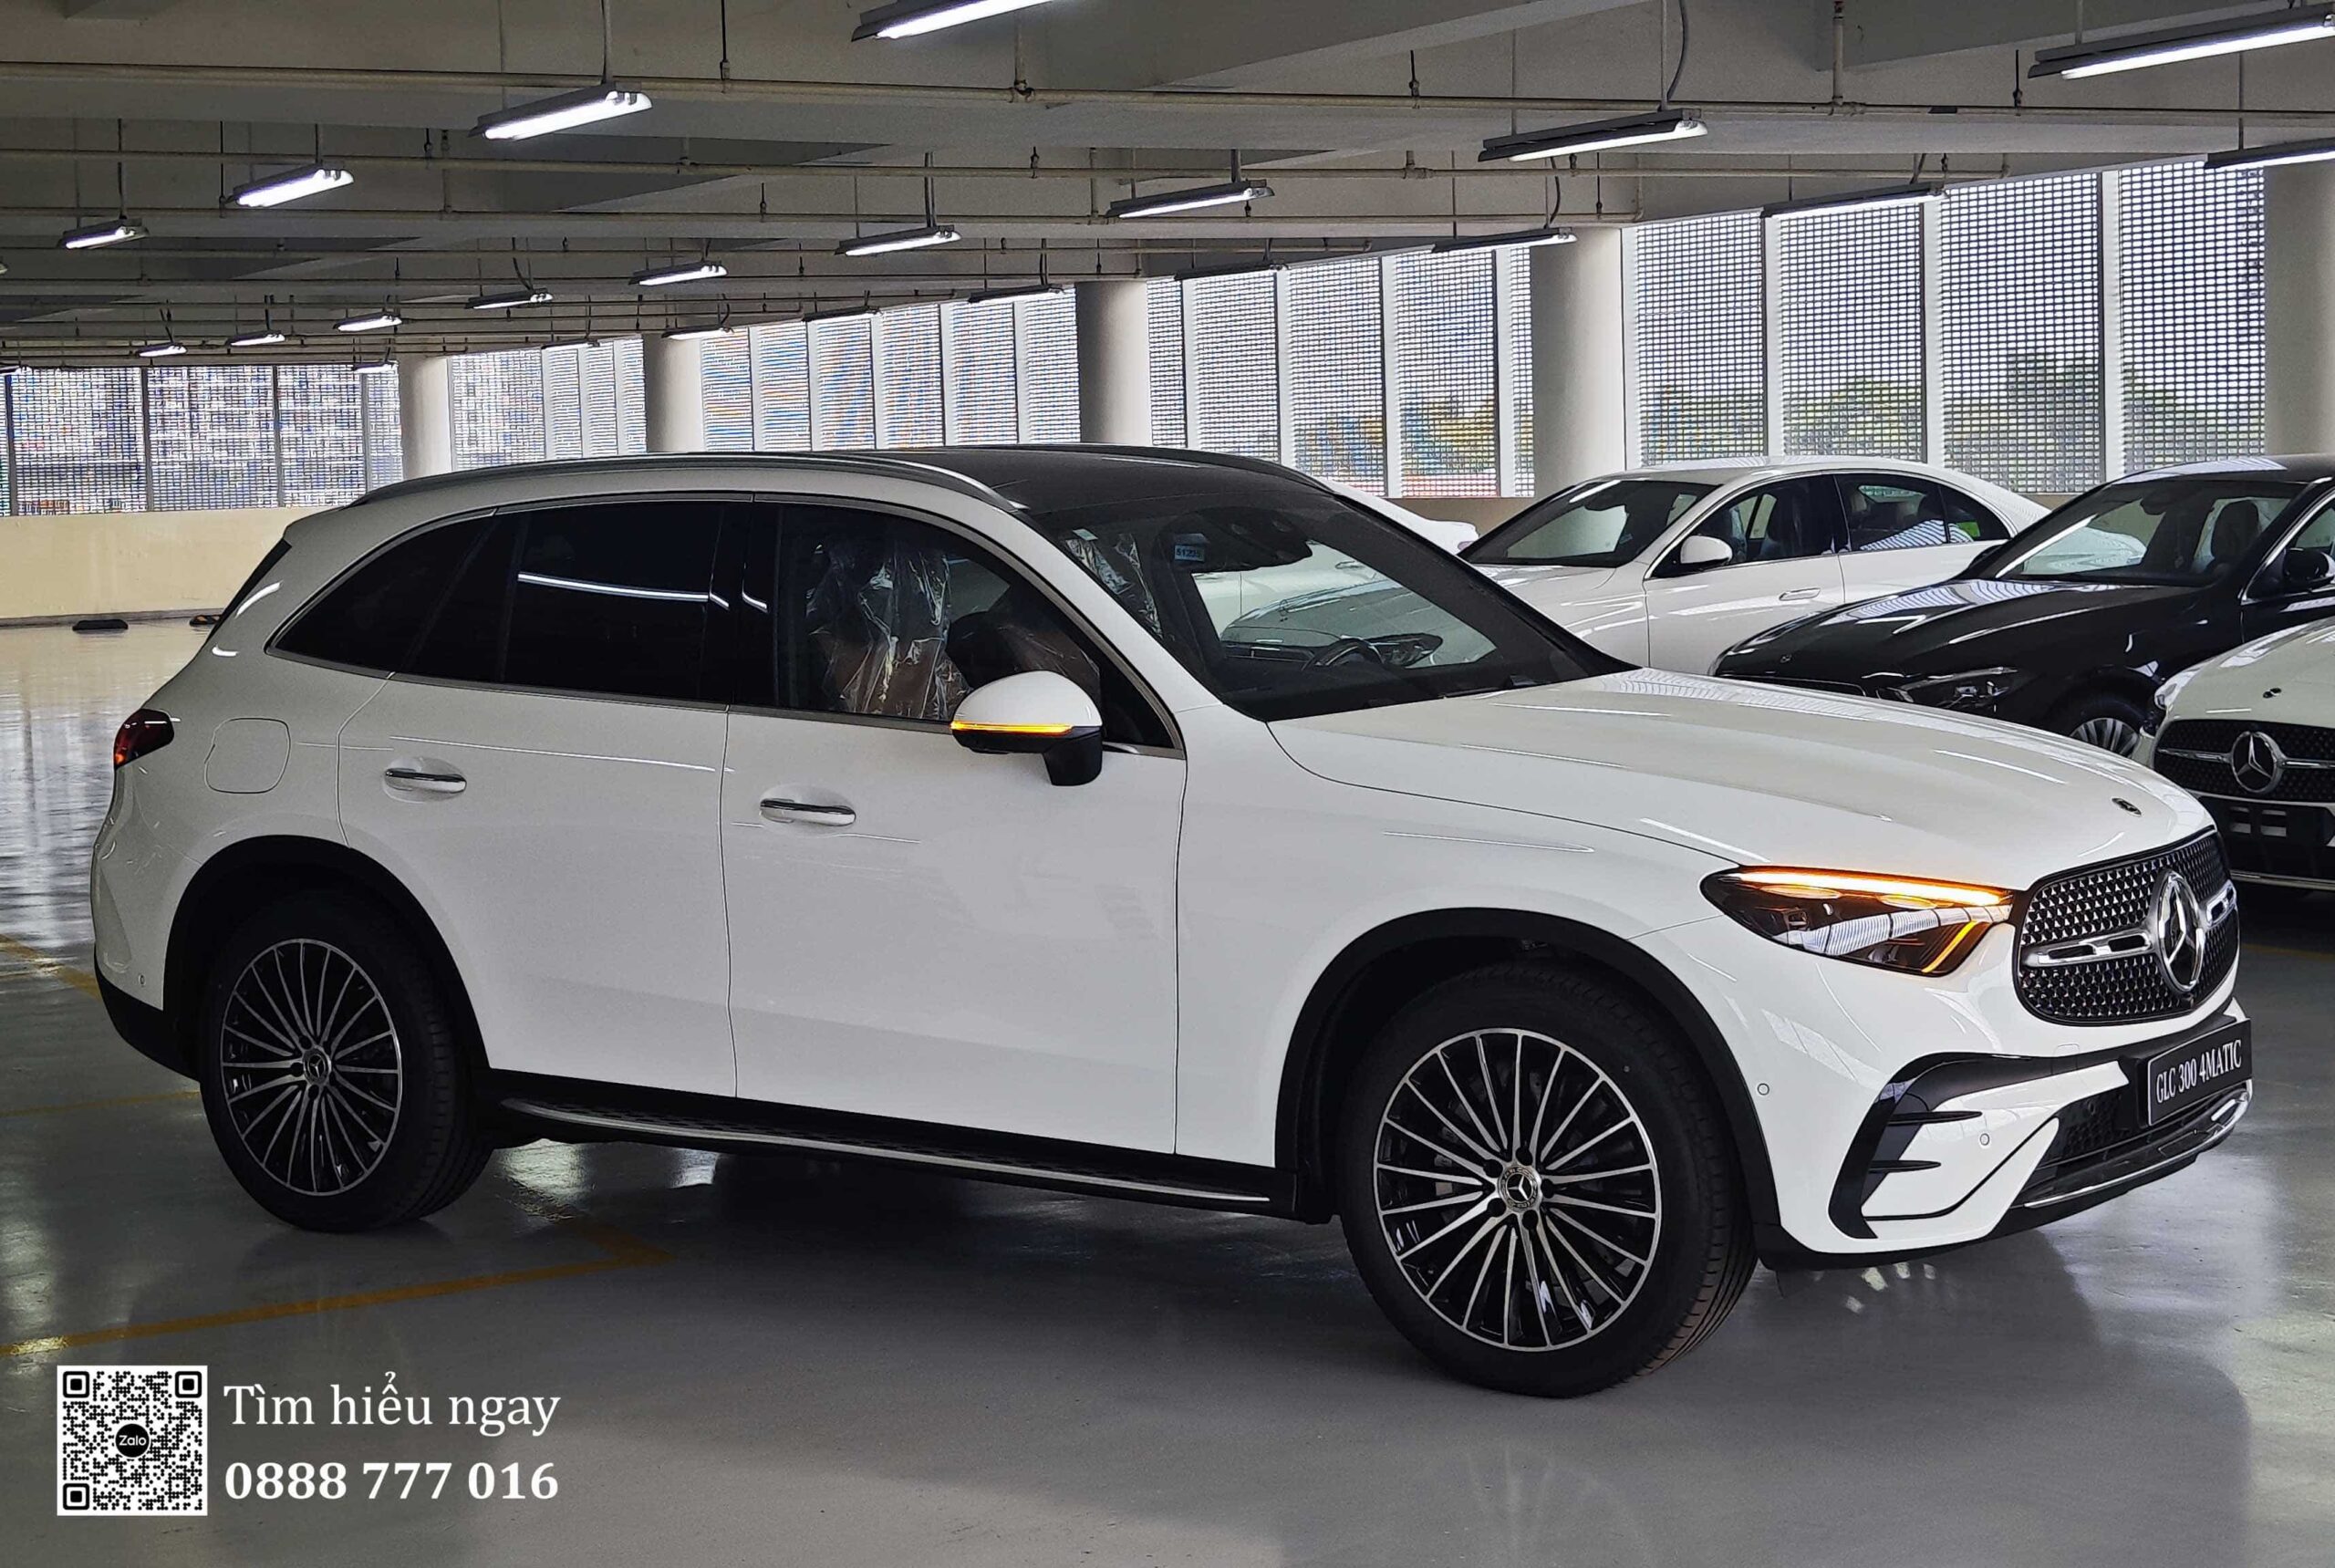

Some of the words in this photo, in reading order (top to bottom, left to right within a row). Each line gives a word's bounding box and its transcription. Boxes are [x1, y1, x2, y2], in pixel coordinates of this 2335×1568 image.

[2155, 1067, 2176, 1104] GLC
[2178, 1058, 2197, 1094] 300
[2198, 1039, 2242, 1084] 4MATIC
